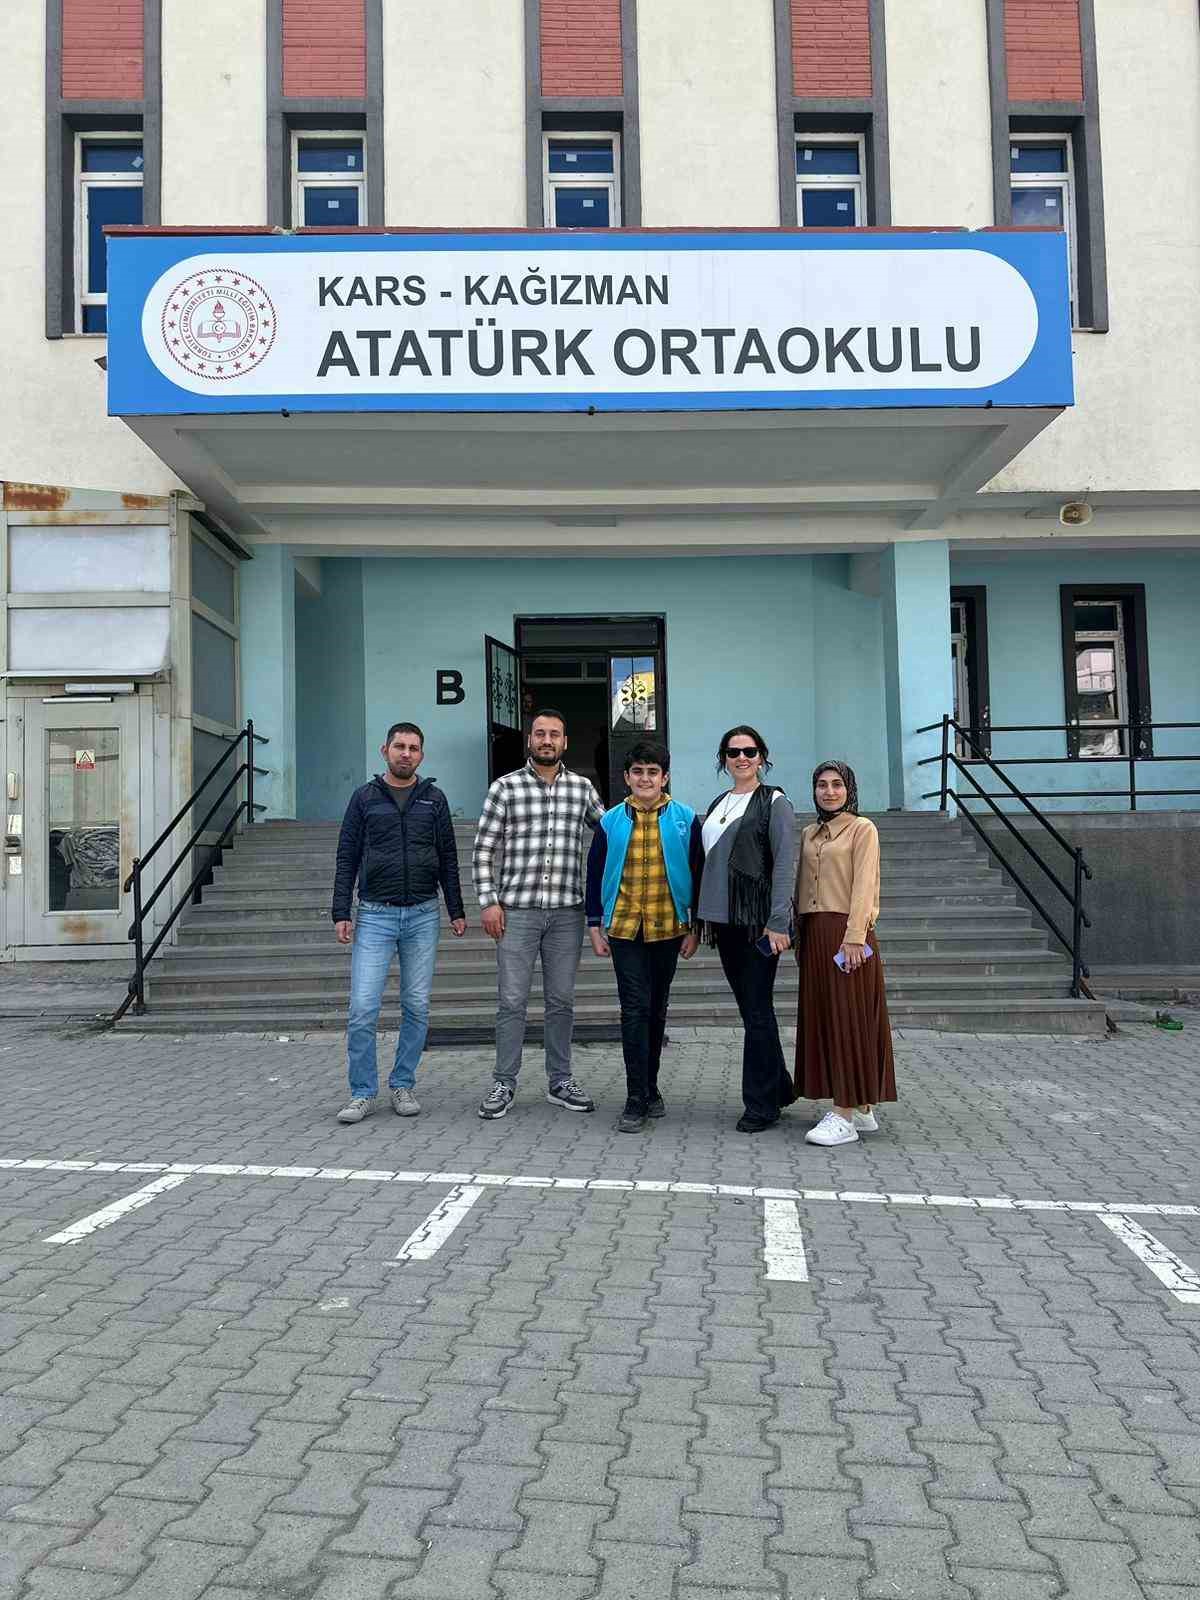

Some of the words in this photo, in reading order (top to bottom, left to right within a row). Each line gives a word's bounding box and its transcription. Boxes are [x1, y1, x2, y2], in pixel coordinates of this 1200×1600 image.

[319, 275, 425, 307] KARS
[439, 291, 452, 299] -
[465, 266, 669, 306] KAĞIZMAN
[317, 317, 595, 377] ATATÜRK
[614, 326, 981, 377] ORTAOKULU
[436, 669, 466, 706] B
